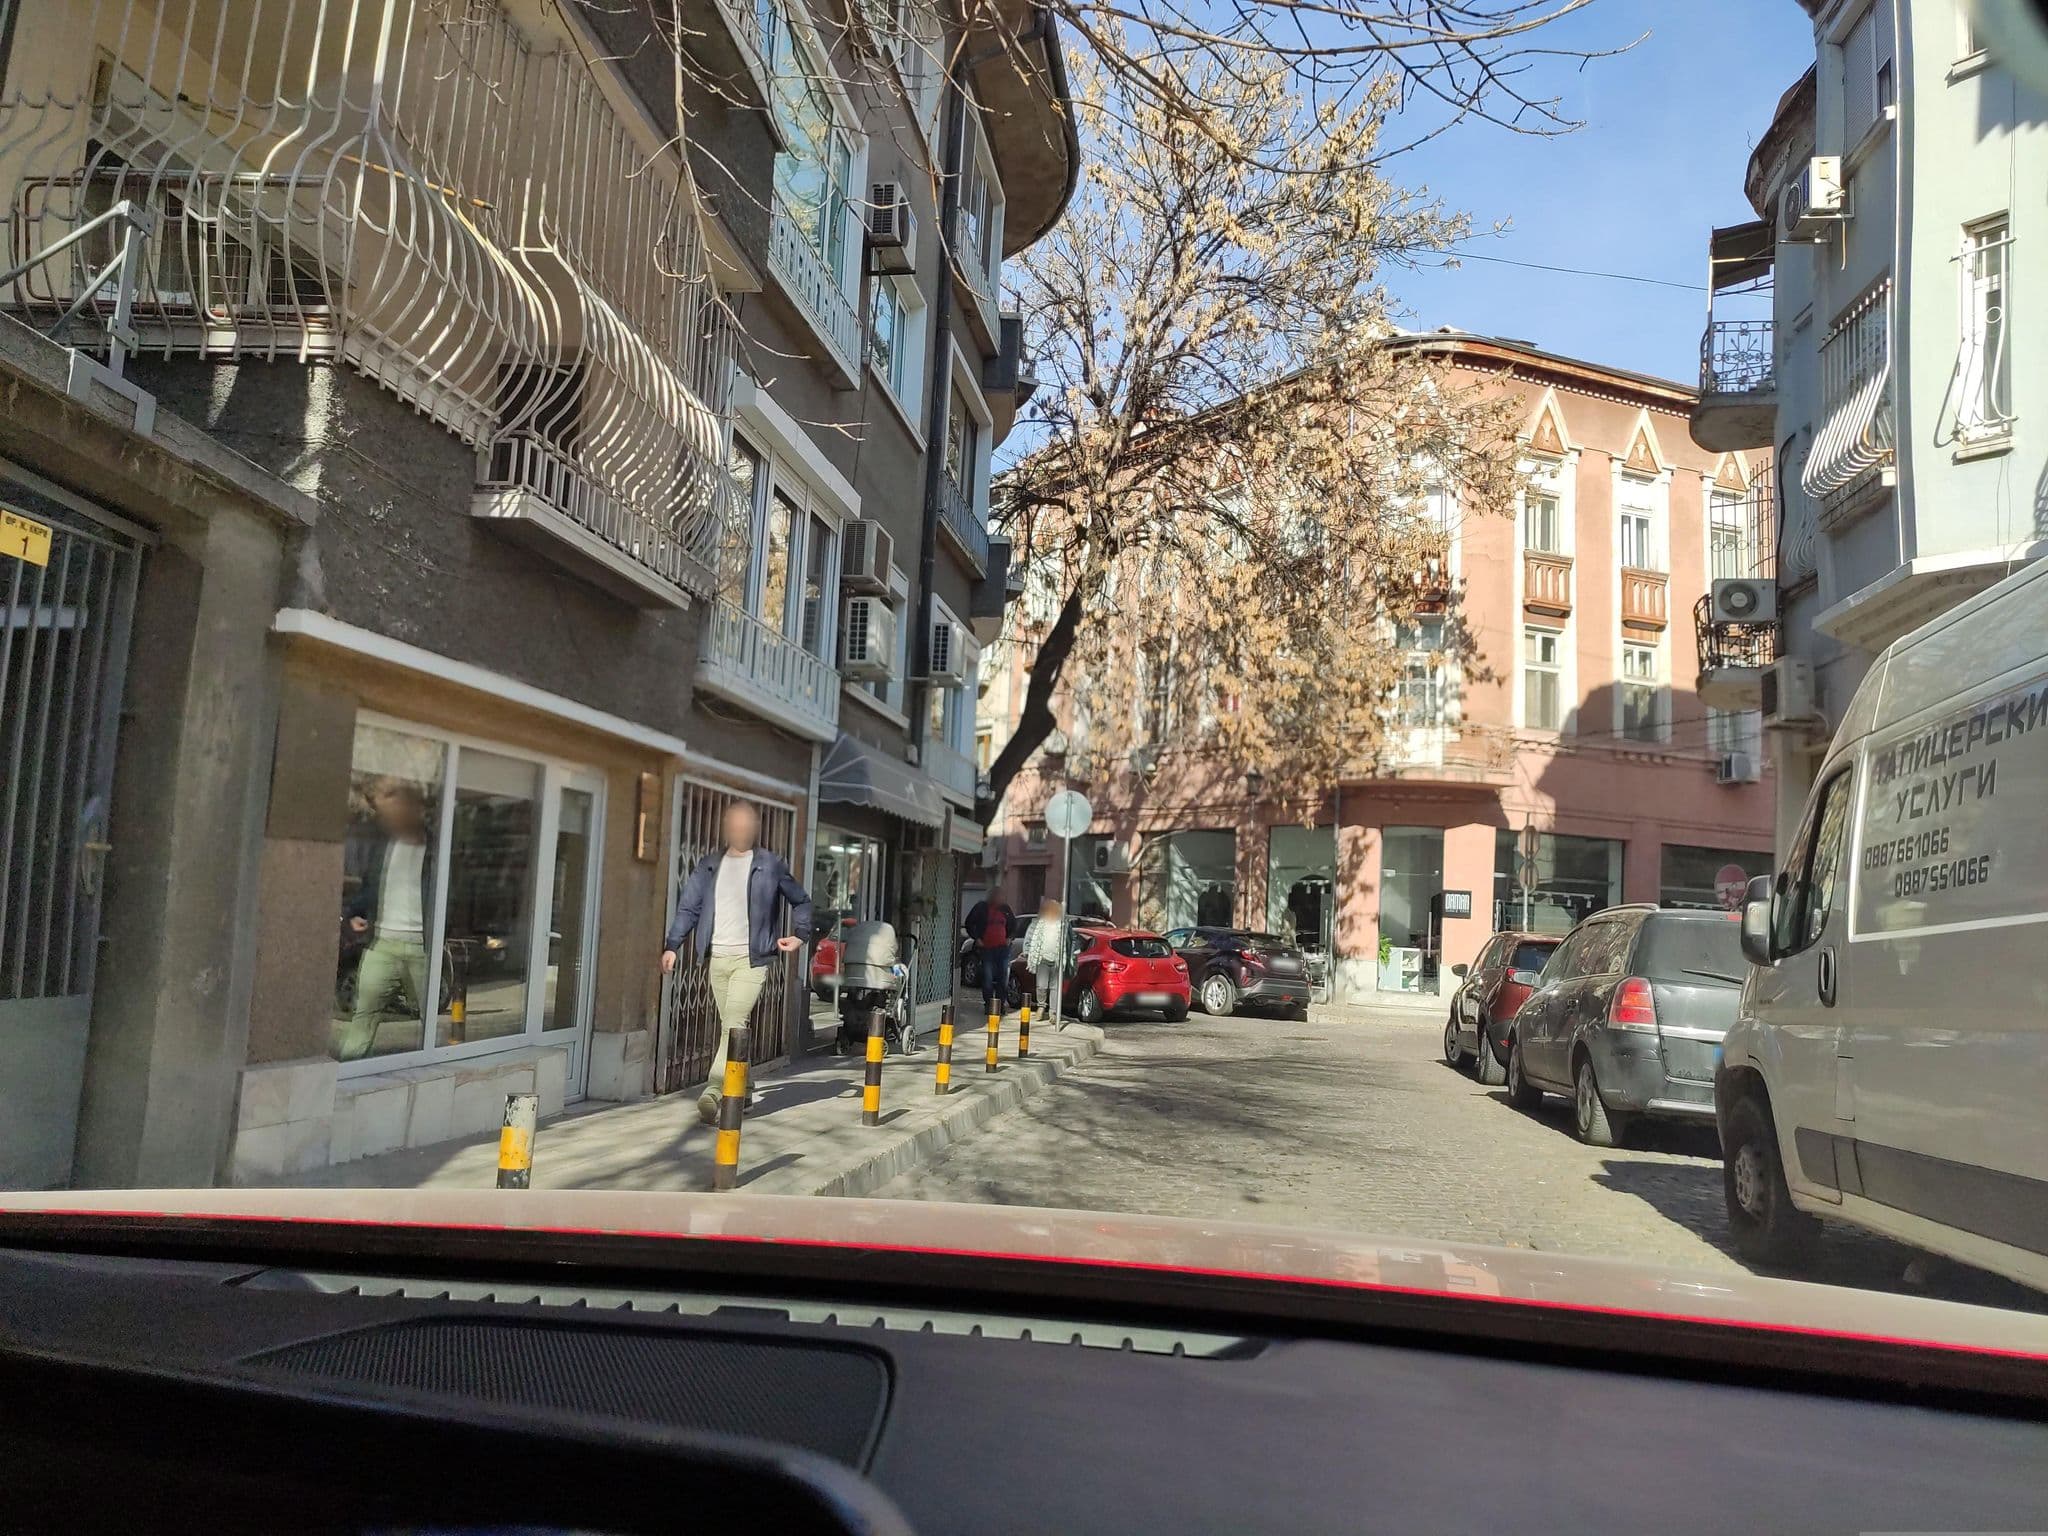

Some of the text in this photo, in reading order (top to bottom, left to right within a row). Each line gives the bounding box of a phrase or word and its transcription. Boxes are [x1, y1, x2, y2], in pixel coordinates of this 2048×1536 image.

[21, 535, 29, 556] 1
[1896, 758, 1997, 824] УСЛУГИ
[1894, 854, 1990, 898] 0887551066
